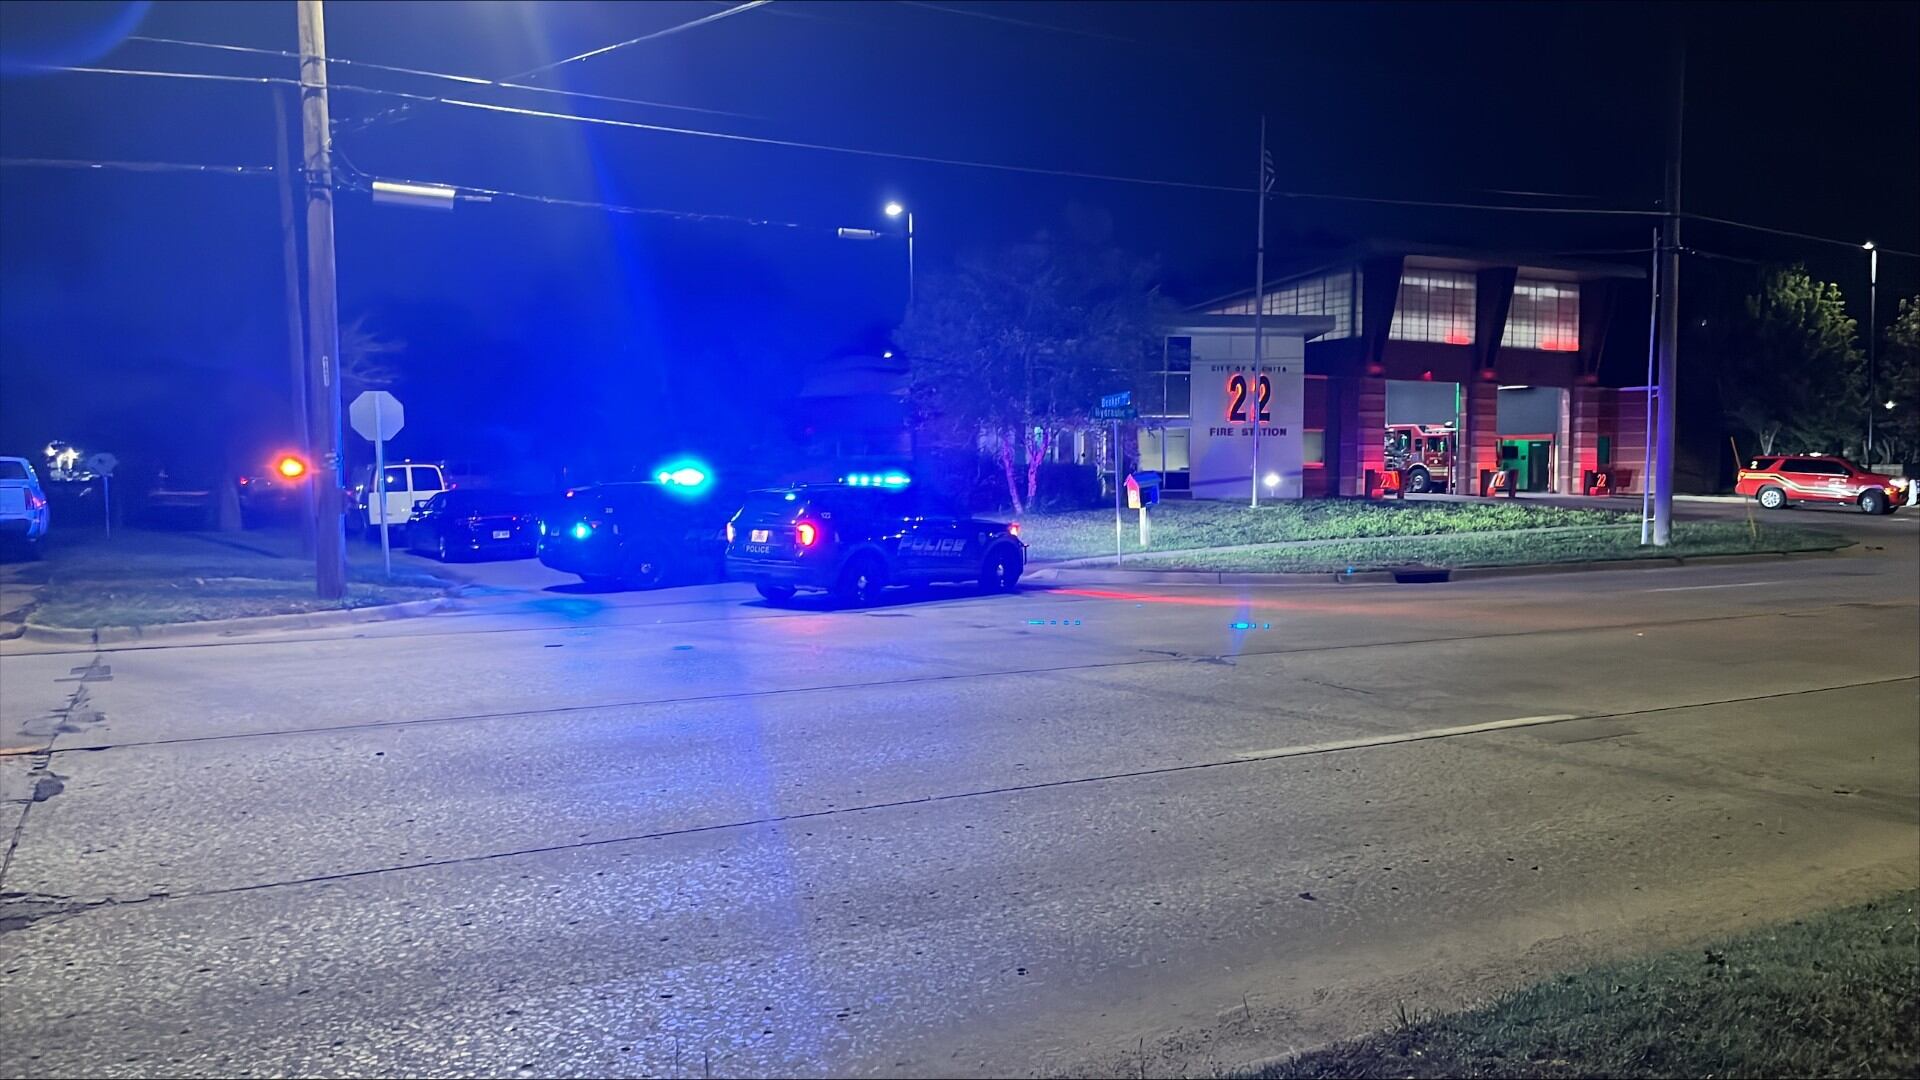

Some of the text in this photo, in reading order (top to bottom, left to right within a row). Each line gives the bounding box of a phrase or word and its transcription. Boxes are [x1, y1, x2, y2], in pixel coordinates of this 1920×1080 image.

[1229, 375, 1271, 421] 22
[1209, 427, 1234, 436] FIRE
[1596, 473, 1607, 487] 22
[745, 544, 770, 554] POLICE
[897, 536, 967, 552] POLICE
